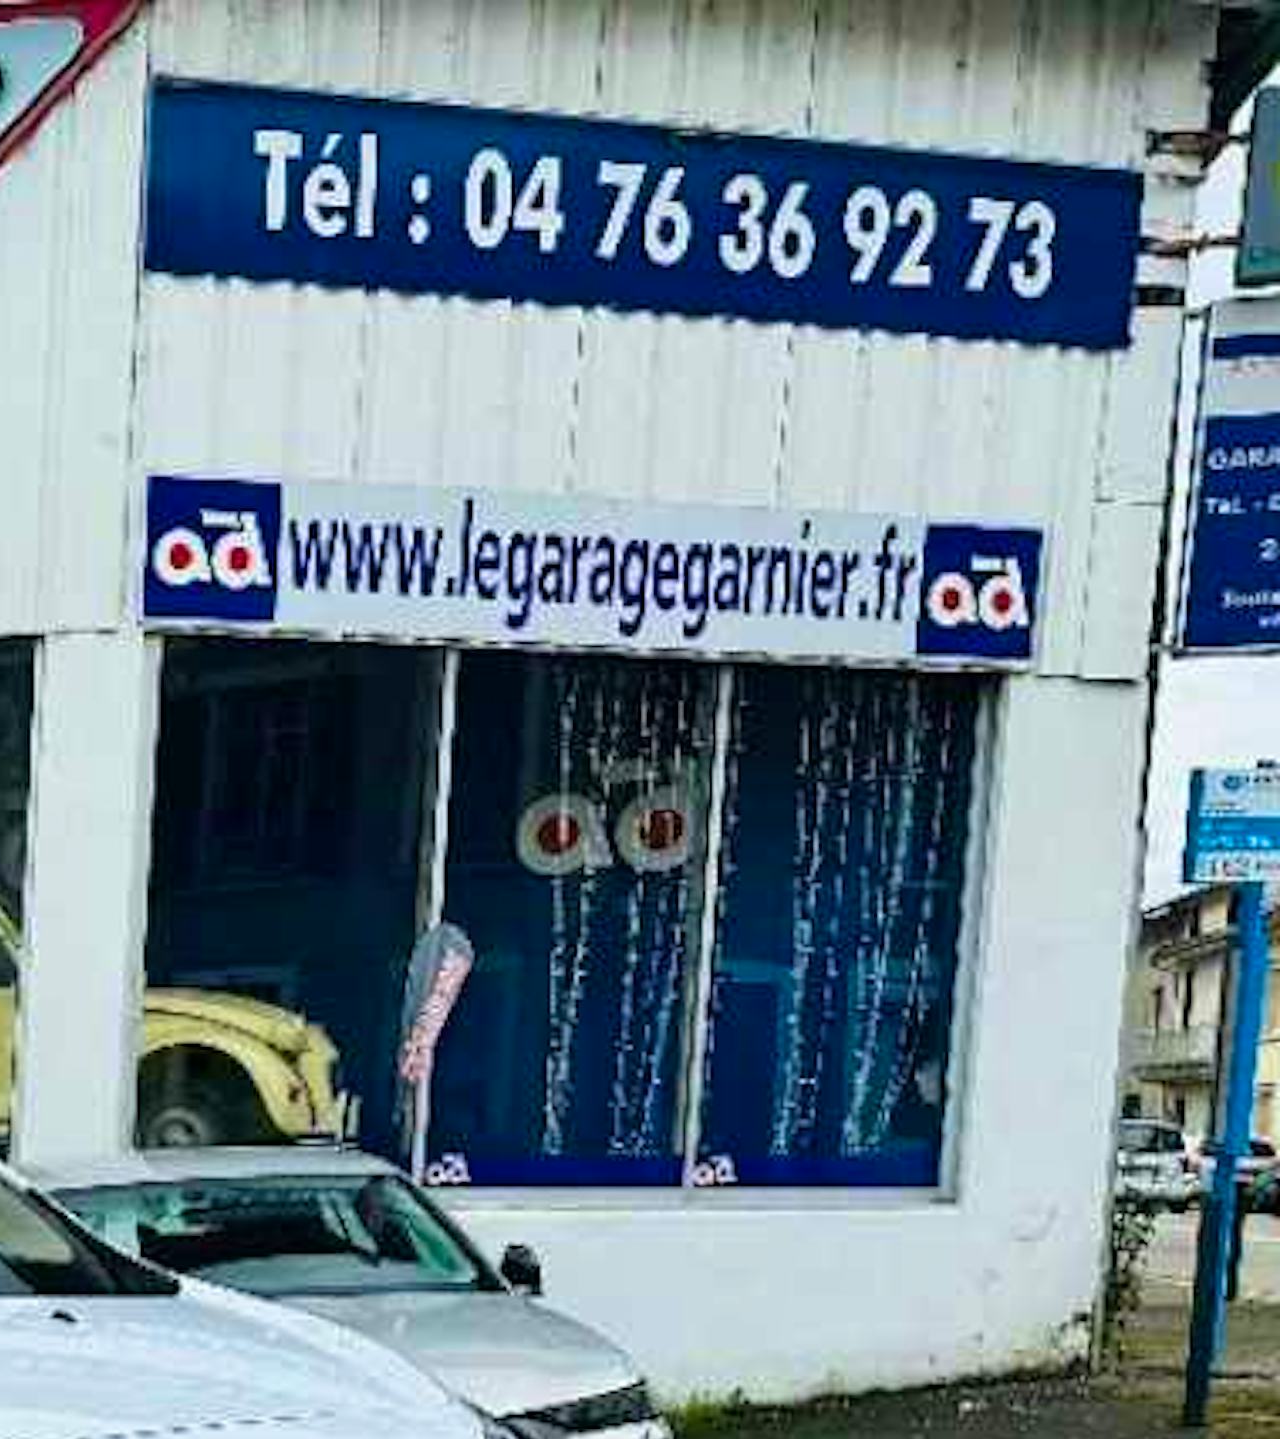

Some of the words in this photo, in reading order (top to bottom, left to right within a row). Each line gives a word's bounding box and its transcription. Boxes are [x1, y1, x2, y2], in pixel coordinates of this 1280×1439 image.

[254, 128, 379, 238] Tél
[464, 147, 563, 255] 04
[595, 161, 692, 267] 76
[719, 172, 817, 278] 36
[844, 185, 939, 289] 92
[965, 196, 1057, 299] 73
[289, 497, 918, 637] www.legaragegarnier.fr
